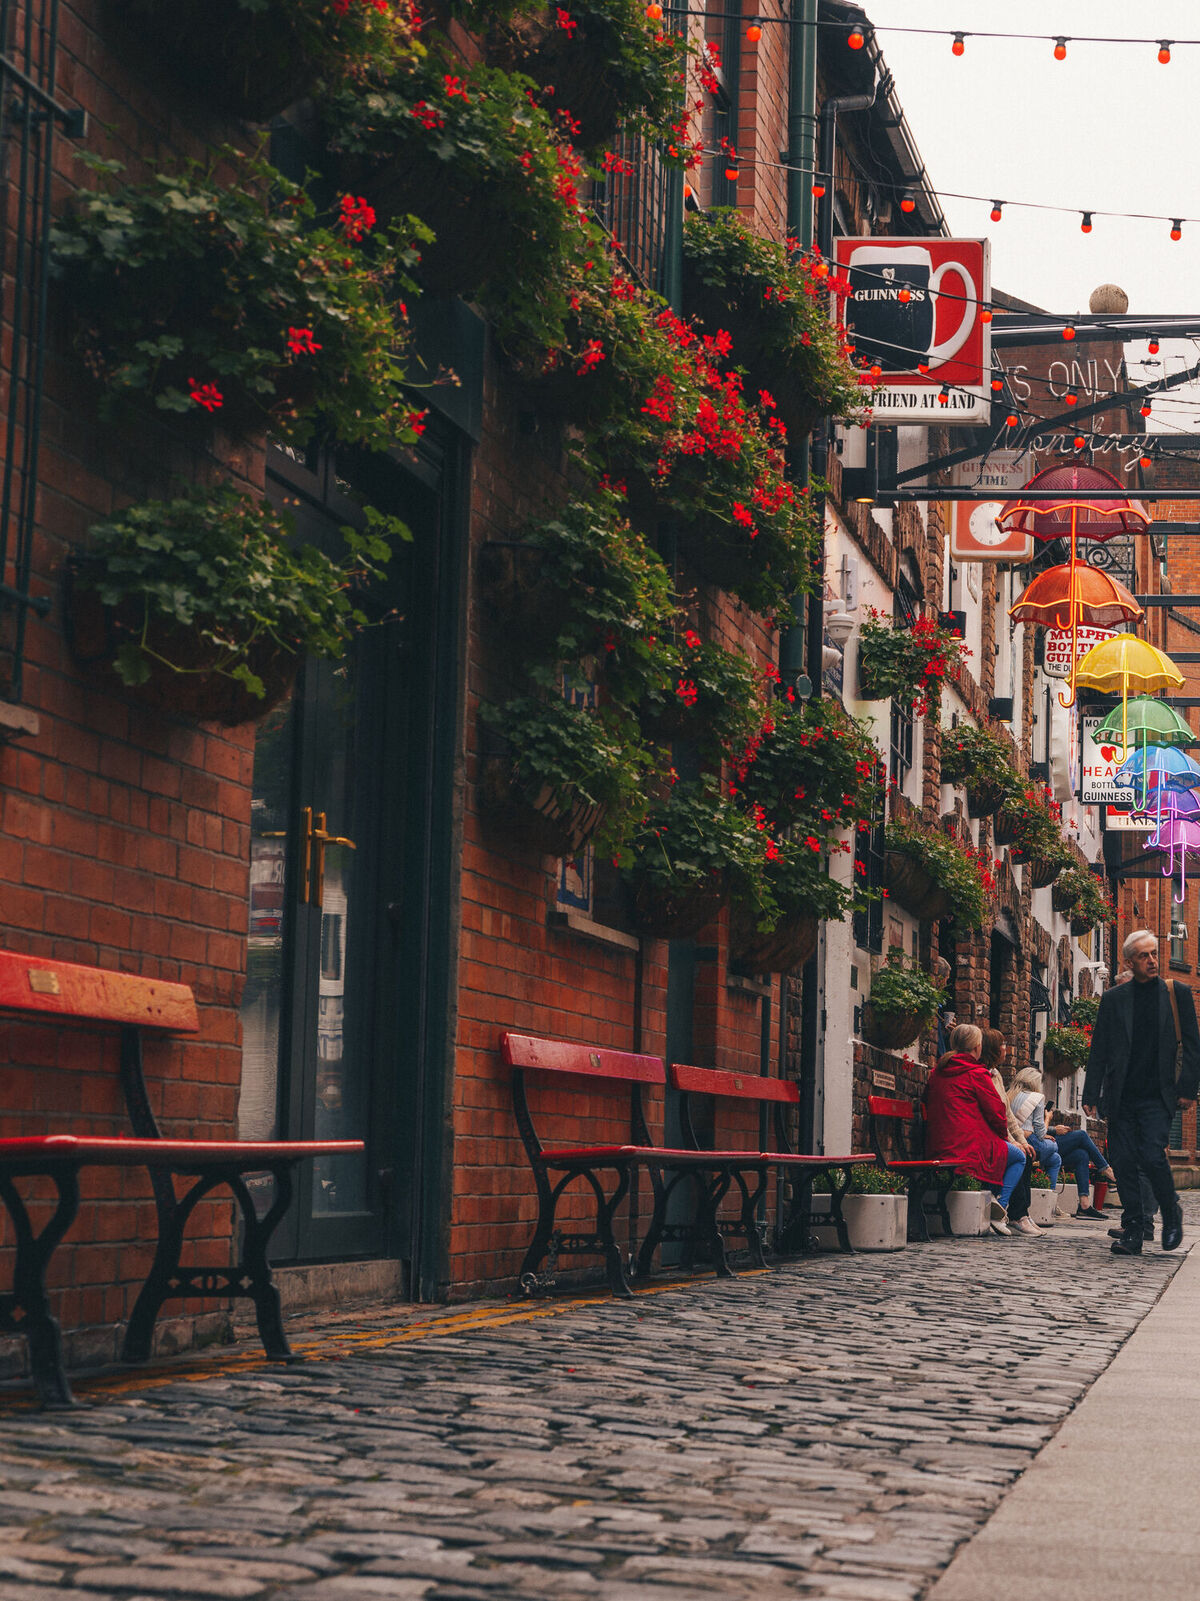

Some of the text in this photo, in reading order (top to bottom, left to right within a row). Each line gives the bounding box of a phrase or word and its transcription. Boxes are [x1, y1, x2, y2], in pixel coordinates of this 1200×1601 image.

[855, 288, 925, 301] GUINNSS
[1049, 358, 1123, 398] ONLY
[871, 393, 917, 408] FRIEND
[920, 393, 937, 408] AT
[977, 475, 1008, 485] TIME
[1048, 663, 1061, 671] THE
[1083, 766, 1134, 776] HEART
[1084, 792, 1132, 801] GUINNESS
